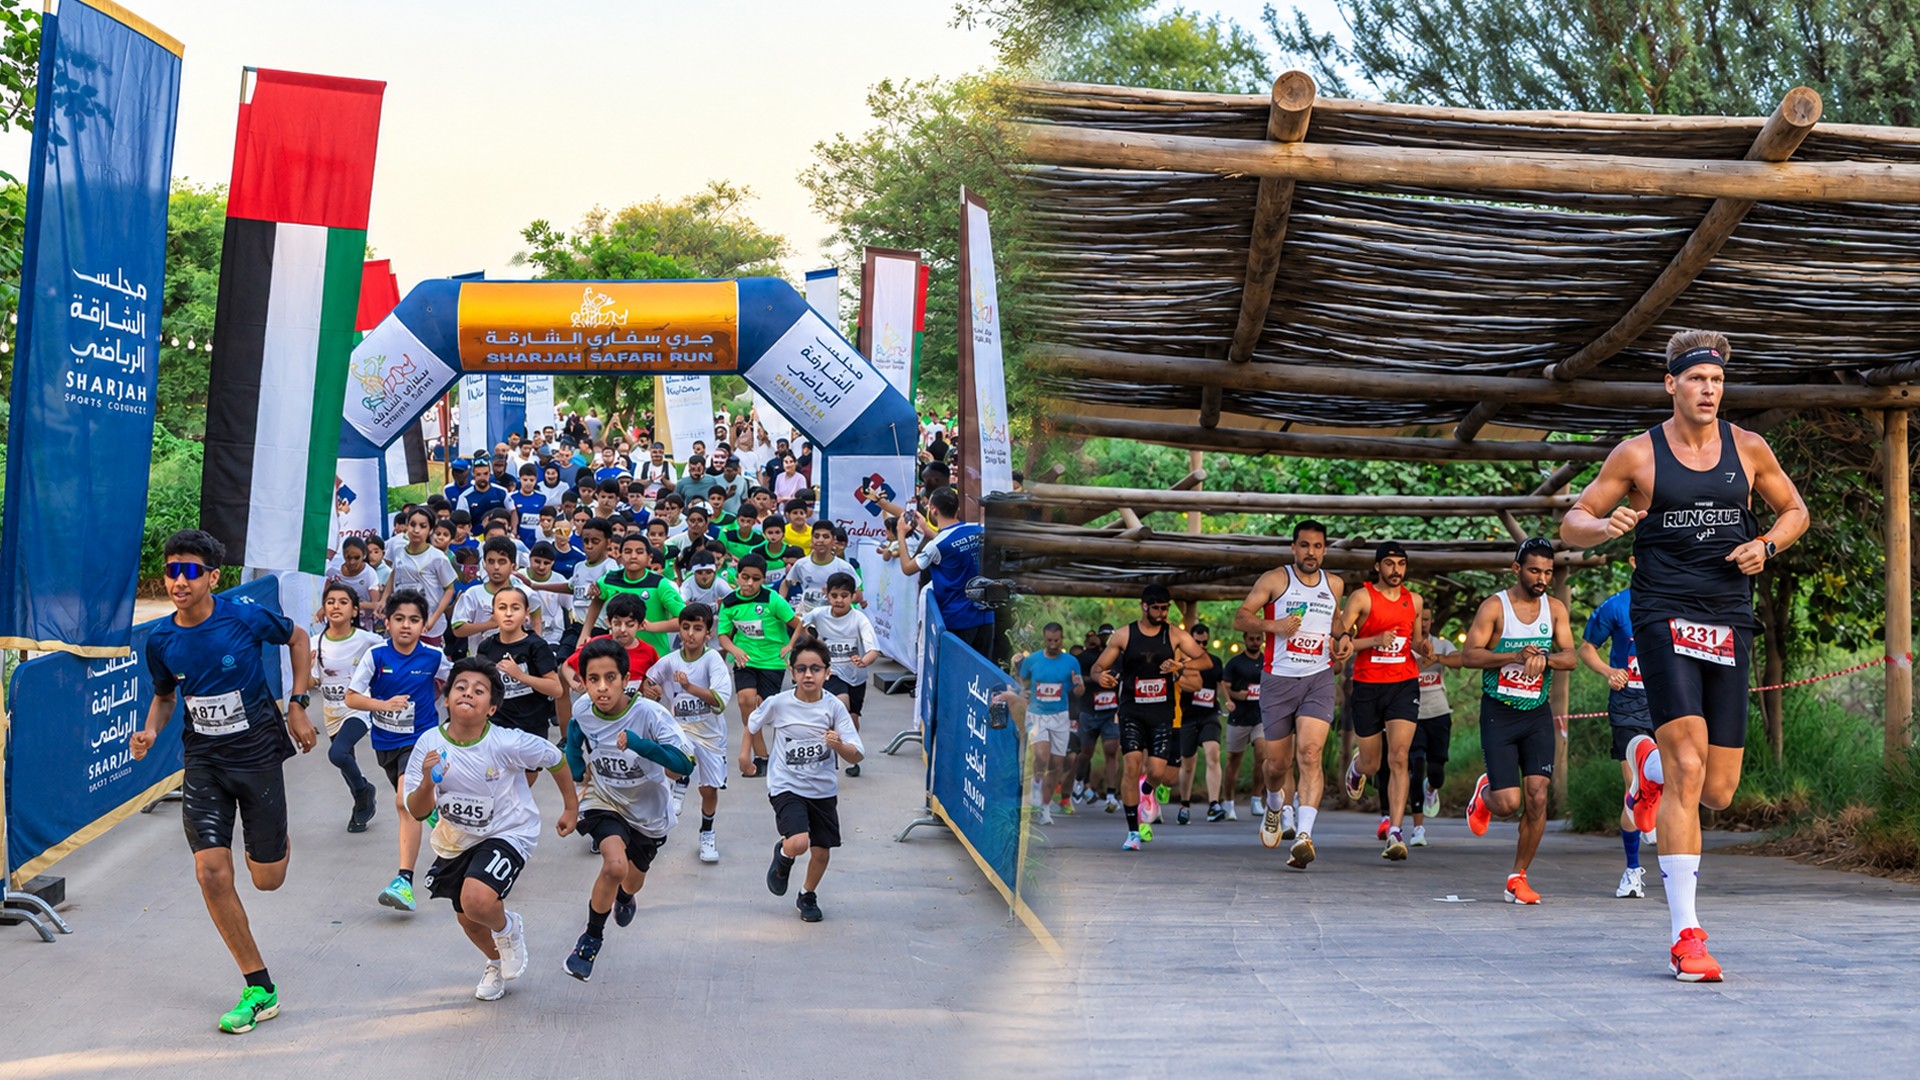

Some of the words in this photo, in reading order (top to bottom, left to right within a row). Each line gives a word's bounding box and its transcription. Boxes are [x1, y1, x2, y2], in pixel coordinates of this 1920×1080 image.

[72, 267, 147, 301] مجلس
[70, 293, 146, 339] الشارقة
[485, 328, 582, 348] الشارقة
[666, 334, 714, 350] جري
[69, 337, 146, 374] الرياضي
[486, 352, 582, 364] SHARJAH
[589, 352, 662, 363] SAFARI
[670, 352, 713, 362] RUN
[800, 345, 855, 394] الشارقة
[65, 370, 147, 402] SHARJAH
[786, 364, 841, 408] الرياضي
[1663, 510, 1701, 528] RUN
[1686, 626, 1717, 645] 231
[452, 802, 484, 819] 845
[484, 848, 512, 881] 10
